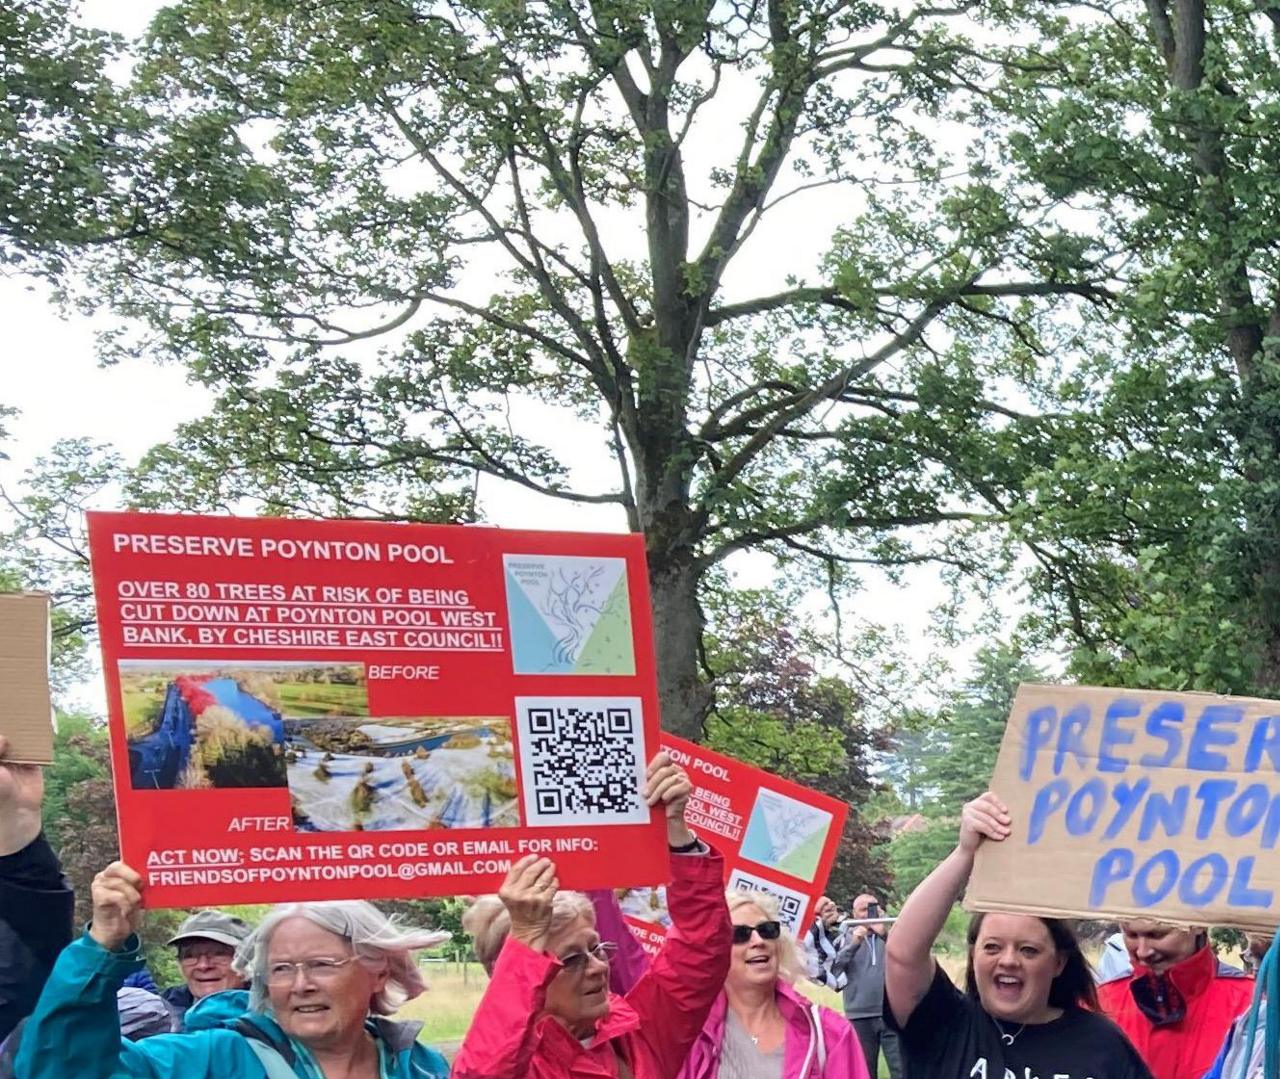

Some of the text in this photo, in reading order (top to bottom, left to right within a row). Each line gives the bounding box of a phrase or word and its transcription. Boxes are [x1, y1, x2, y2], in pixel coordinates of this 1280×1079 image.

[113, 534, 454, 564] PRESERVE POYNTON POOL
[118, 581, 469, 606] OVER 80 TREES AT RISK OF BEING
[121, 604, 496, 627] CUT DOWN AT POYNTON POOL WEST
[123, 627, 502, 648] BANK, BY CHESHIRE EAST COUNCIL!!
[368, 665, 440, 680] BEFORE
[660, 744, 731, 782] TON POOL
[694, 786, 731, 807] BEING
[227, 816, 291, 832] AFTER
[684, 810, 741, 841] COUNCIL!!
[709, 804, 743, 825] WEST
[147, 850, 187, 866] ACT
[250, 847, 302, 862] SCAN
[306, 845, 343, 860] THE
[348, 844, 375, 860] QR
[379, 842, 430, 858] CODE
[433, 841, 460, 856] OR
[463, 840, 515, 855] EMAIL
[518, 838, 553, 853] FOR
[556, 837, 599, 852] INFO:
[149, 860, 511, 886] FRIENDSOFPOYNTONPOOL@GMAIL.COM
[1088, 847, 1275, 909] POOL
